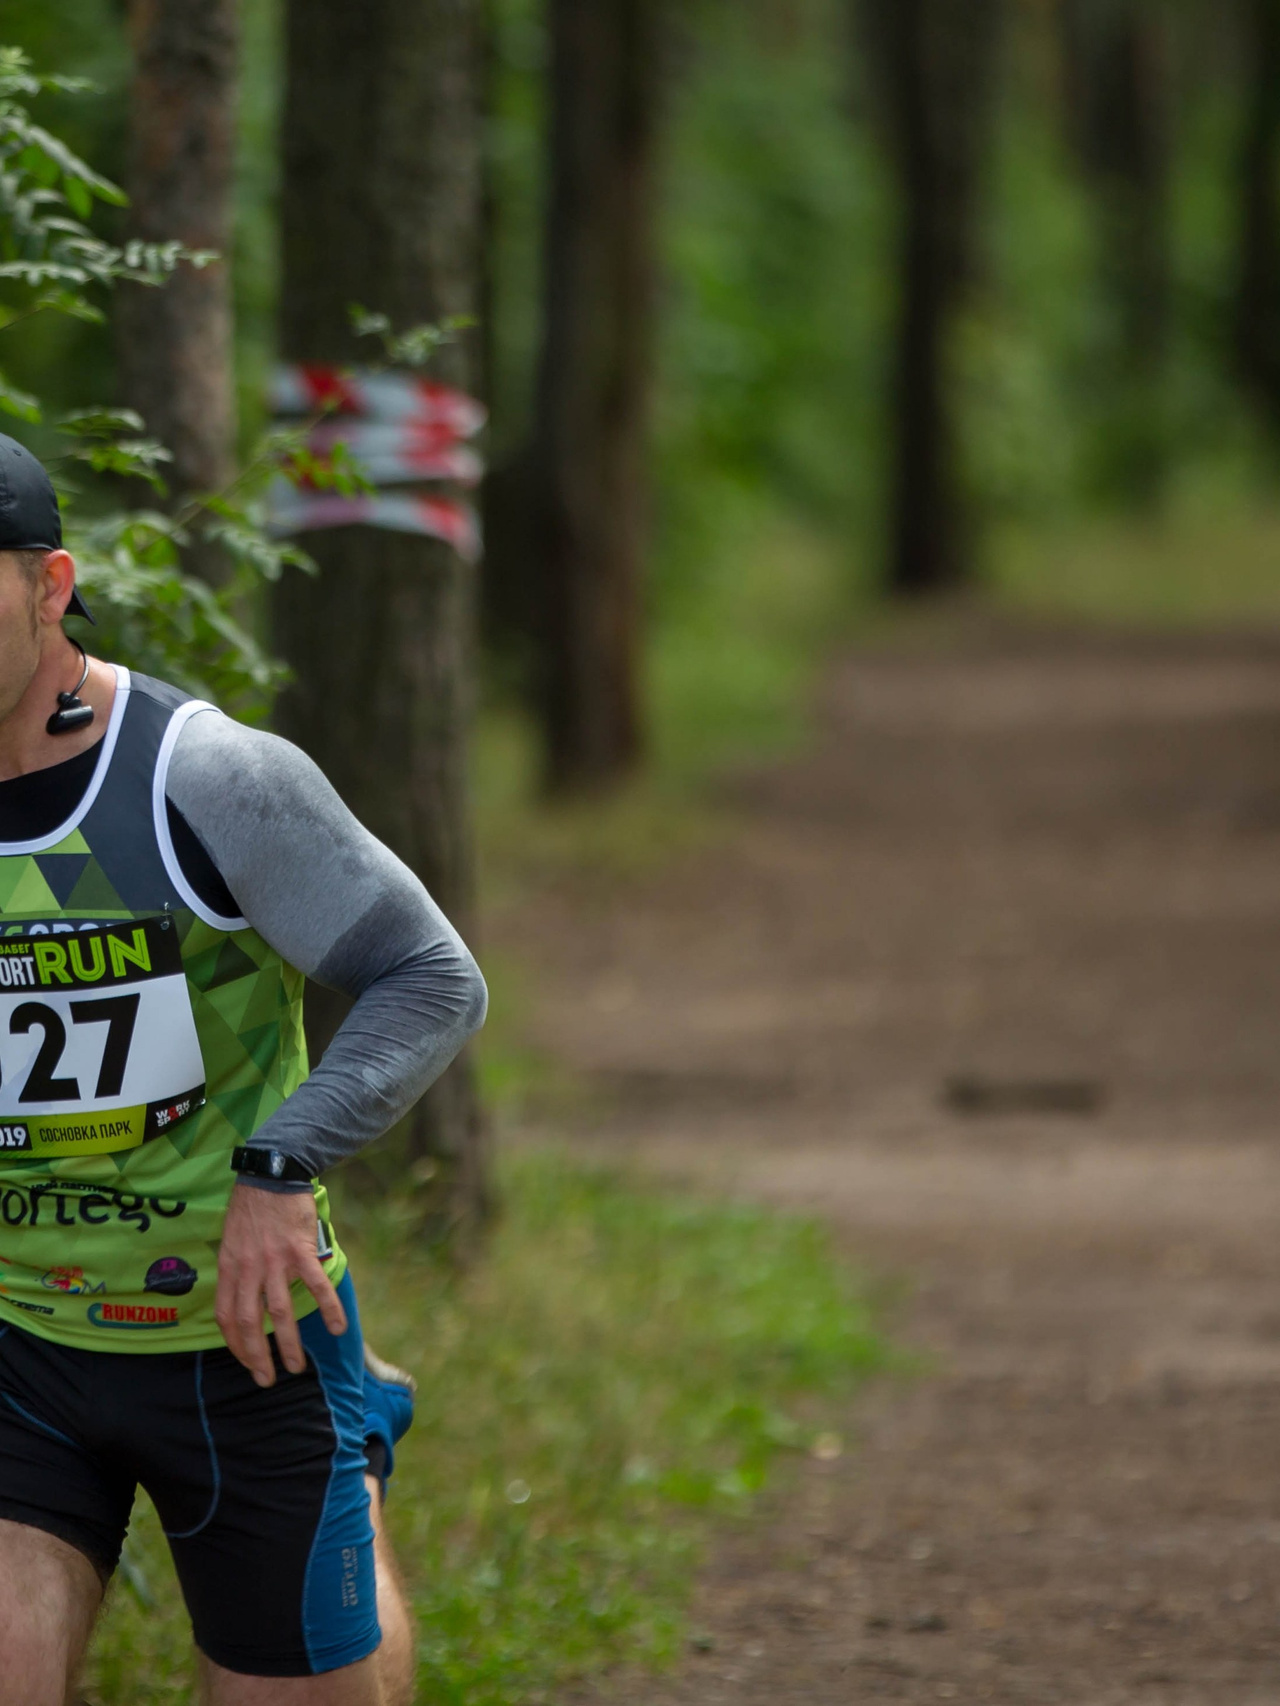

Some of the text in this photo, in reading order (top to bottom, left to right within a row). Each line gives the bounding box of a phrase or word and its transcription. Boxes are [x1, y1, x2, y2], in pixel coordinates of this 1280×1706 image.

[33, 928, 152, 986] RUN
[39, 1120, 133, 1143] СОСНОВКА ПАРК
[102, 1303, 179, 1323] RUNZONE
